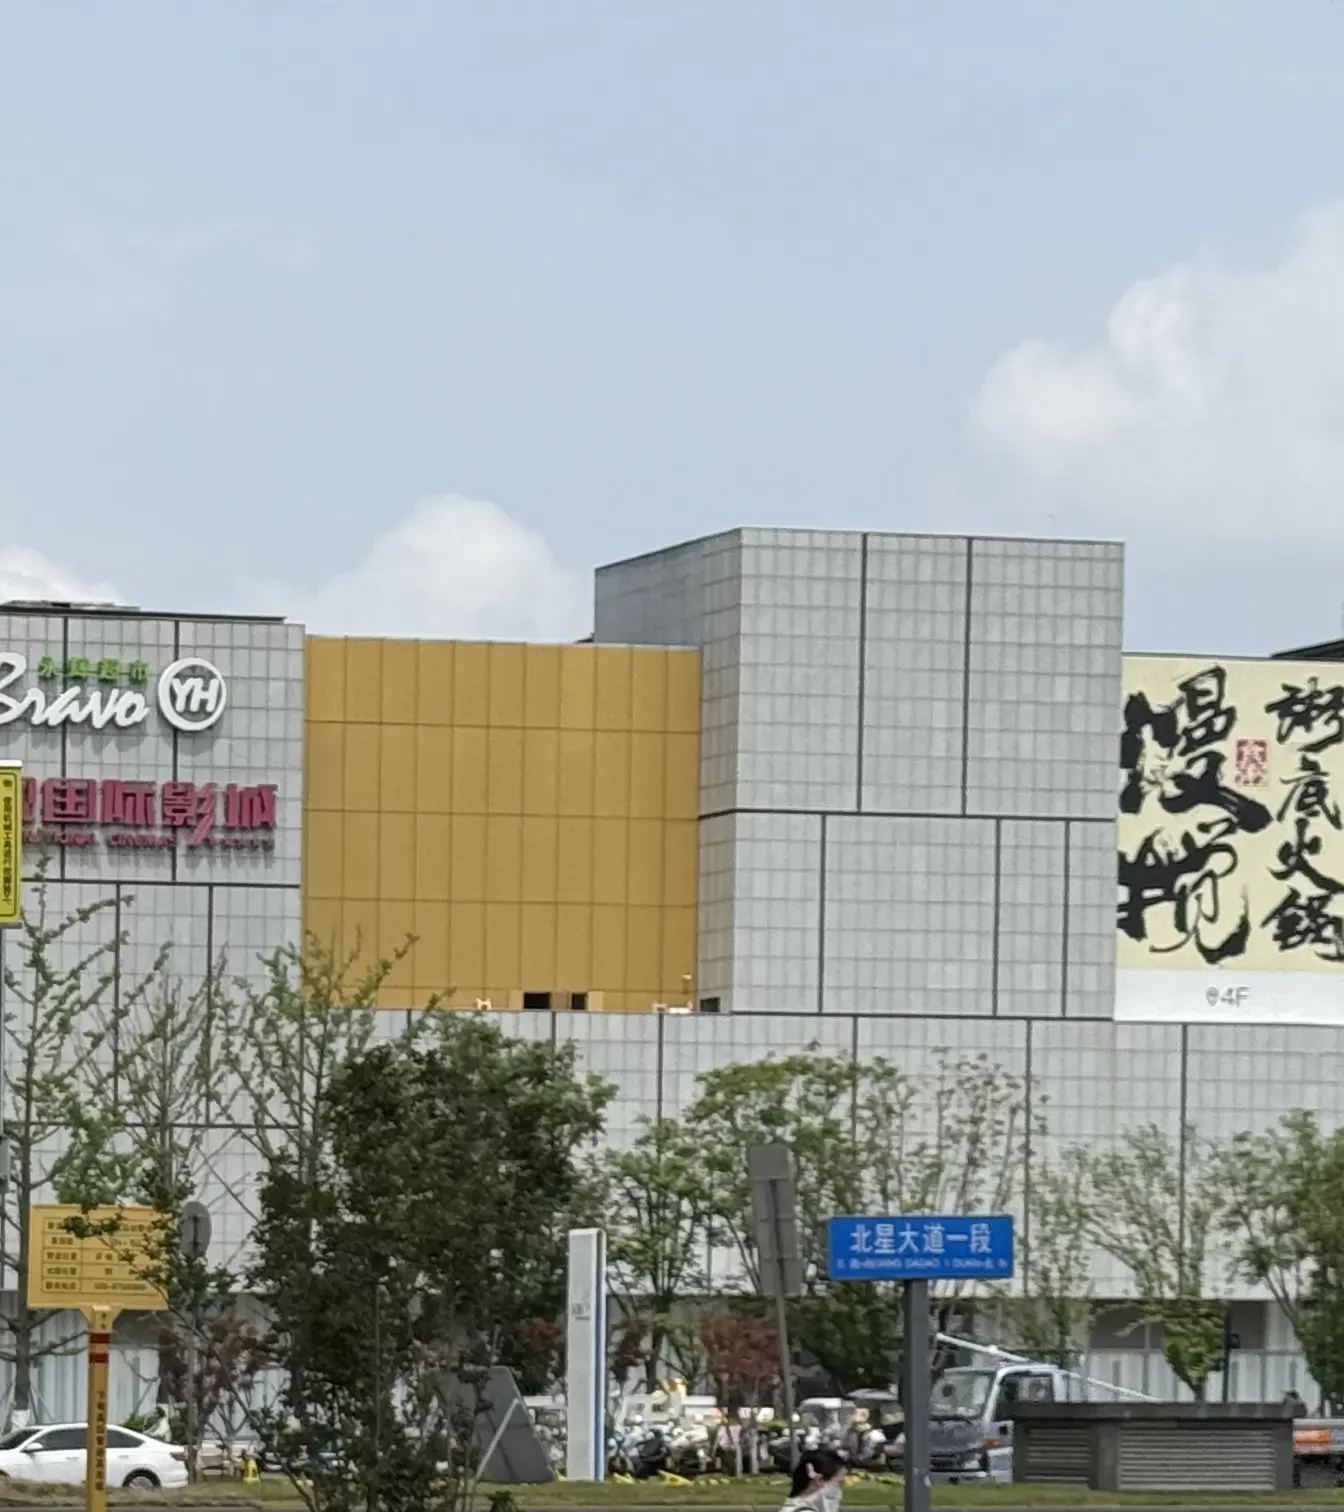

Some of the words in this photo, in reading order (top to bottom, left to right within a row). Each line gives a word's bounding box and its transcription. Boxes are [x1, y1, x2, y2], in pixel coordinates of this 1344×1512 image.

[172, 678, 219, 714] YH
[850, 1223, 991, 1253] 北星大道一段
